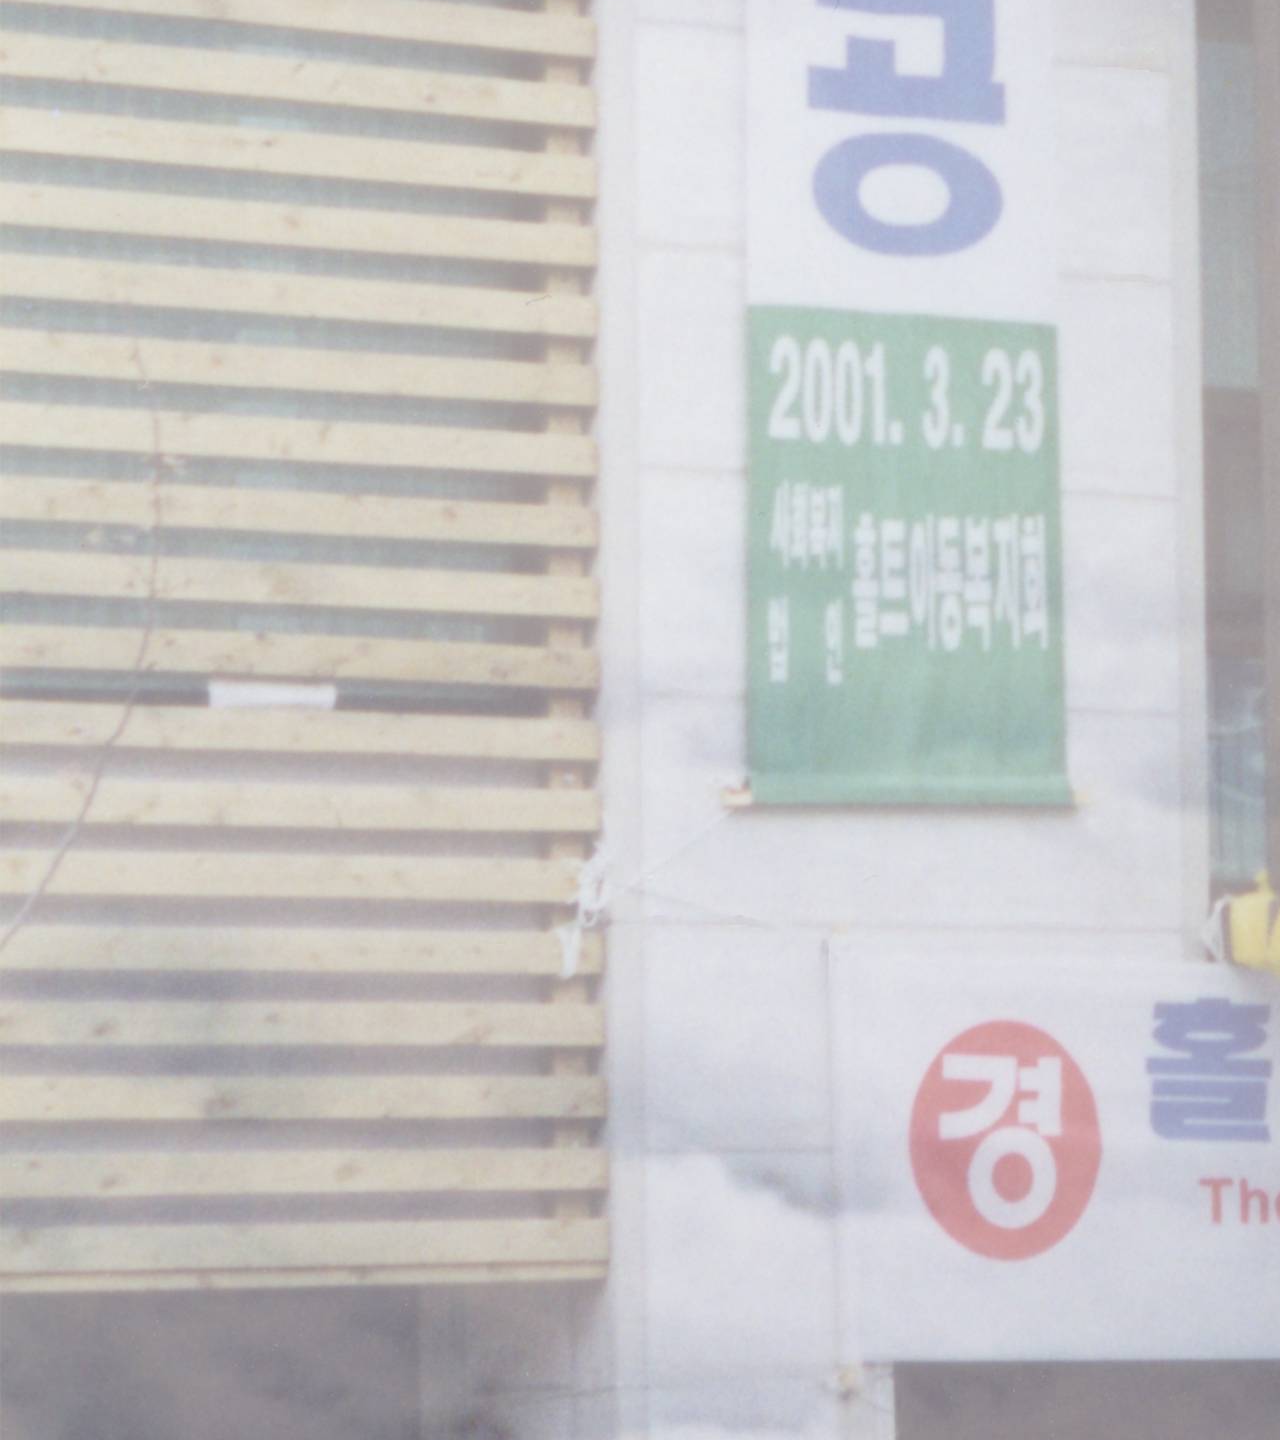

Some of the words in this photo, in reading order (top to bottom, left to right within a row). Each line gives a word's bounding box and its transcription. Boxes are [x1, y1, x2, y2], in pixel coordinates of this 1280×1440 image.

[769, 334, 903, 446] 2001.
[922, 344, 964, 450] 3.
[982, 348, 1045, 453] 23
[853, 513, 1049, 652] 홀트아동복지회
[938, 1053, 1063, 1230] 경
